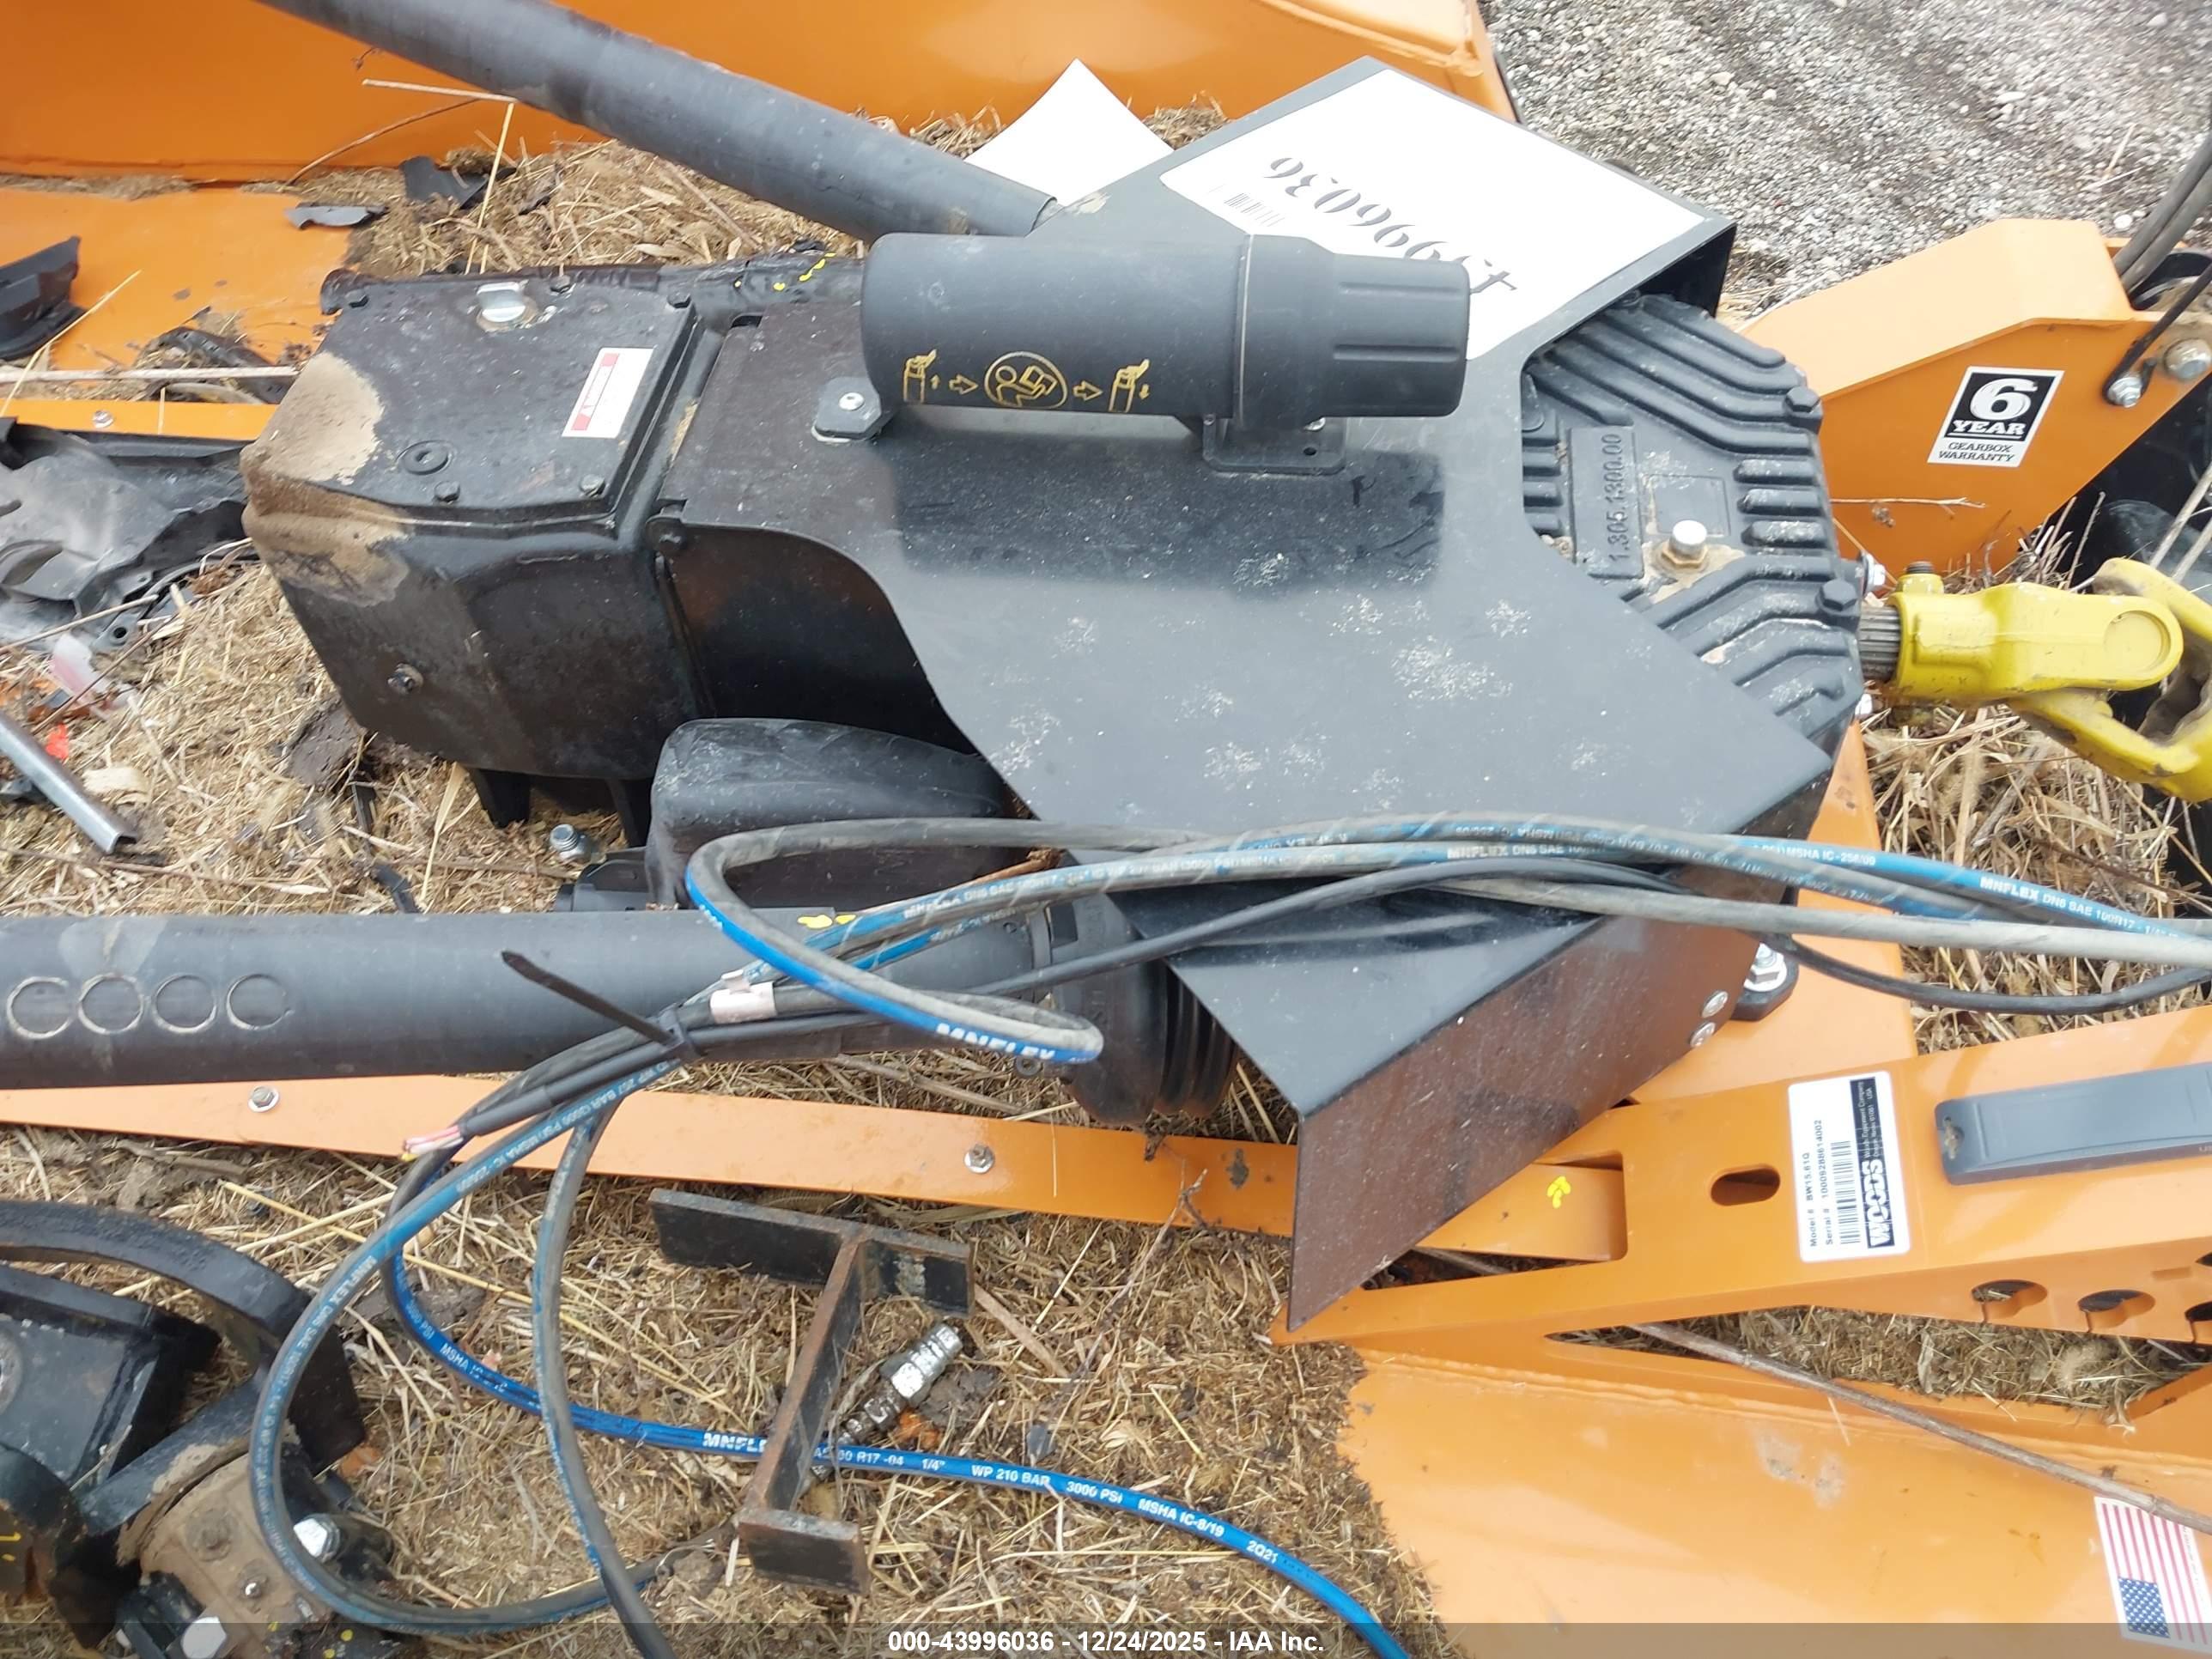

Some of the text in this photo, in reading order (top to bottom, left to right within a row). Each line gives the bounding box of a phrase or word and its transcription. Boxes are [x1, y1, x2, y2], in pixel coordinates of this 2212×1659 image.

[1970, 378, 2039, 421] 6
[1953, 420, 2027, 435] YEAR
[1938, 451, 2015, 462] WARRANTY
[1948, 441, 2013, 453] GEARBOX
[1980, 876, 2040, 902] MNFLEX
[2043, 893, 2067, 908] DN6
[2069, 900, 2093, 917] SAE
[1861, 1158, 1891, 1247] WOODS
[1825, 1216, 1833, 1245] Serial
[439, 1341, 469, 1370] MSHA
[856, 1451, 881, 1464] R17
[921, 1457, 945, 1471] 1/4"
[971, 1464, 994, 1478] WP
[995, 1468, 1018, 1482] 210
[1022, 1471, 1051, 1486] BAR
[1066, 1480, 1098, 1498] 3000
[1099, 1487, 1123, 1504] PSI
[1138, 1498, 1178, 1522] MSHA
[1180, 1511, 1225, 1538] IC-8/19
